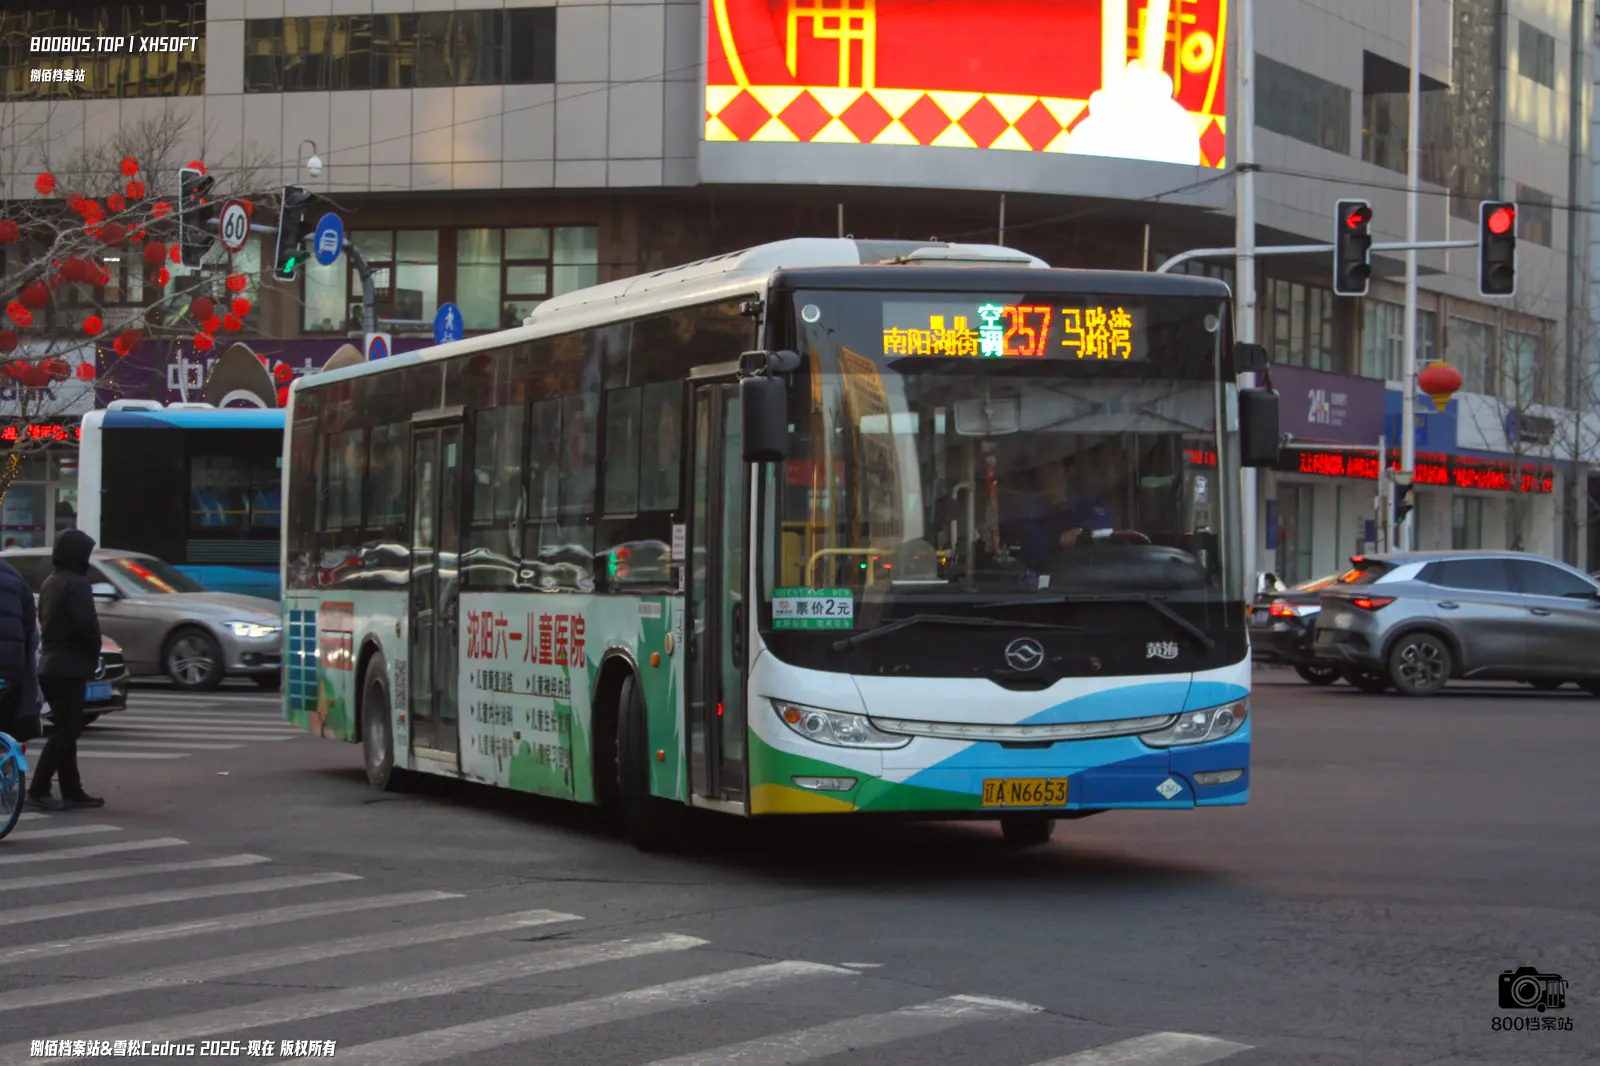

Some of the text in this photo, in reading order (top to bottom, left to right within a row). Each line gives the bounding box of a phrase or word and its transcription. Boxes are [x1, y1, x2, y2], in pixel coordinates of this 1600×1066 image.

[224, 216, 245, 240] 60
[883, 327, 979, 355] 南阳湖街
[1002, 305, 1052, 356] 257
[1061, 307, 1132, 359] 马路湾
[796, 599, 850, 616] 票价2元
[467, 609, 586, 668] 沈阳六一儿童医院
[1146, 641, 1179, 660] 黄海
